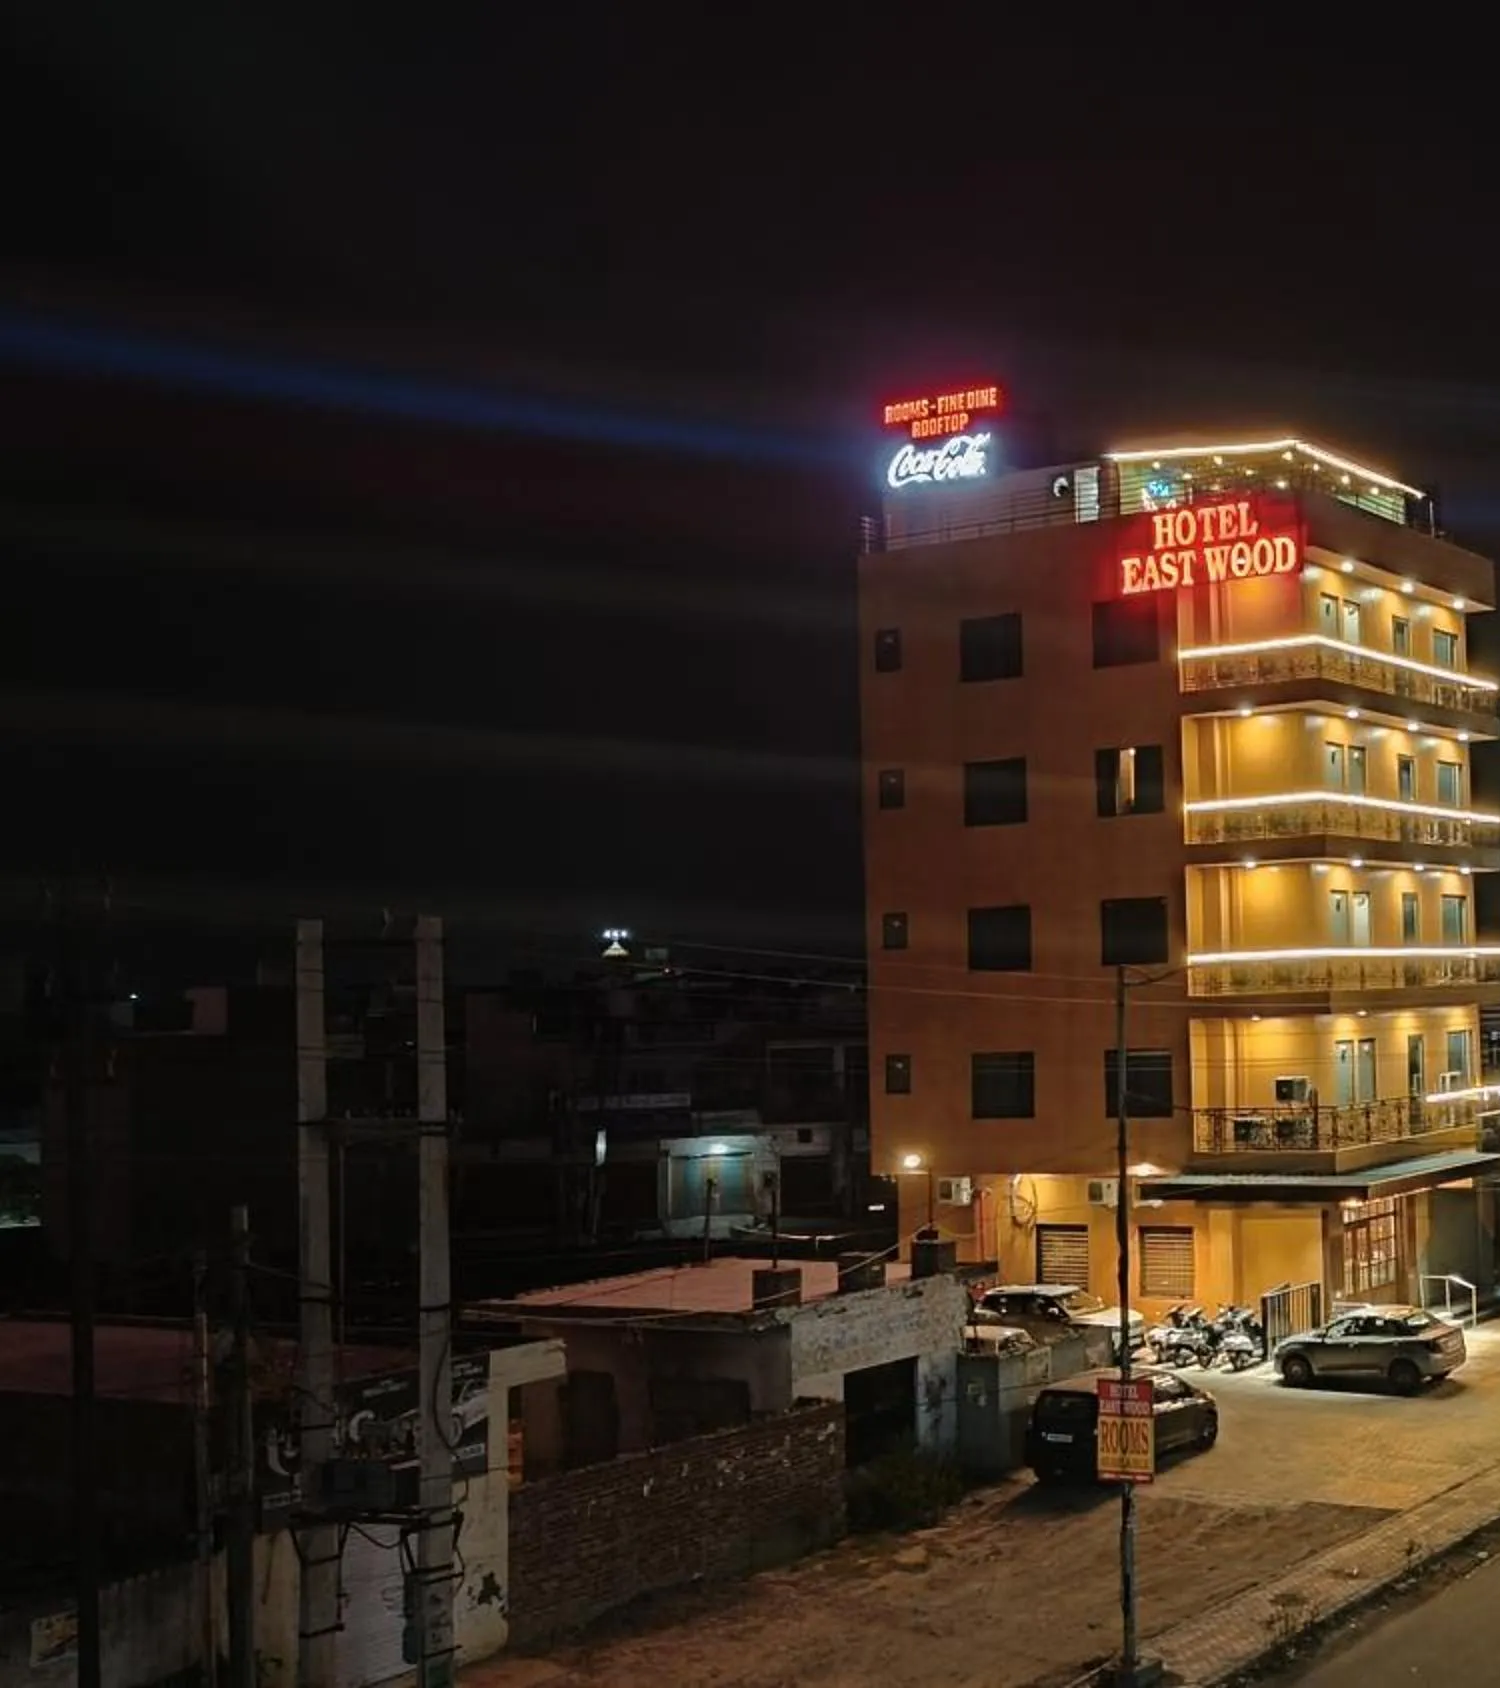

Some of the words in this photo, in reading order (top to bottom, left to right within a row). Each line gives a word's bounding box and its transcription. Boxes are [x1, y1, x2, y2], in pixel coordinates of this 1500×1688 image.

[967, 387, 997, 409] DINE
[911, 413, 969, 438] ROOFTOP
[1152, 502, 1258, 550] HOTEL
[1121, 550, 1196, 595] EAST
[1203, 537, 1296, 582] WOOD
[1100, 1421, 1149, 1454] ROOMS
